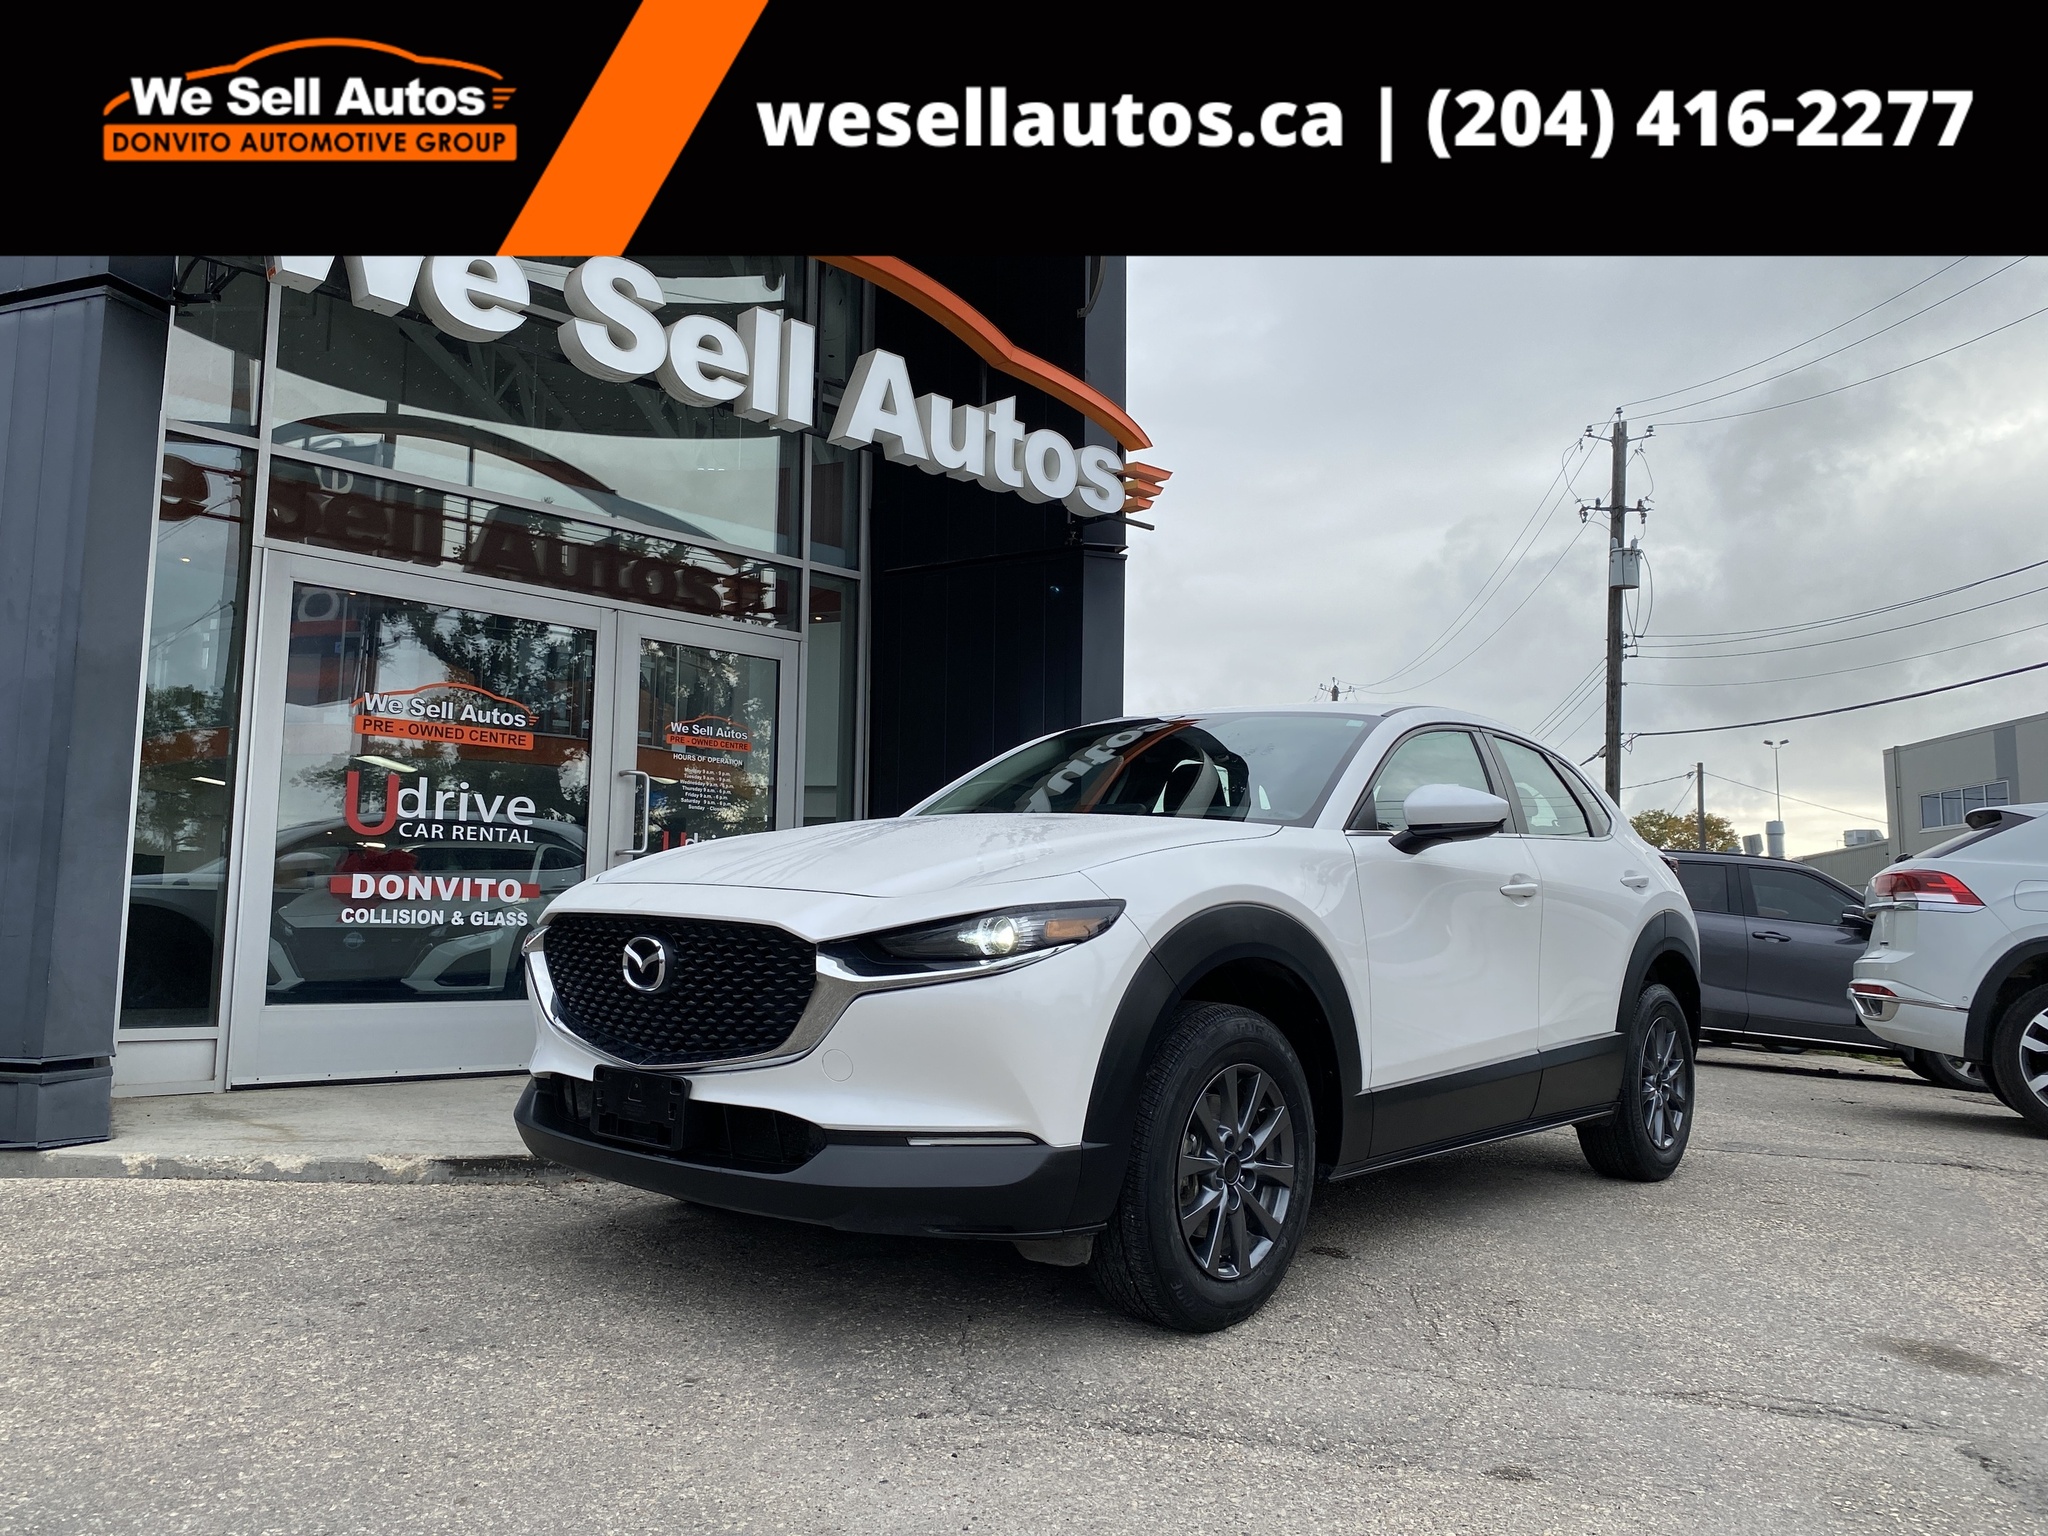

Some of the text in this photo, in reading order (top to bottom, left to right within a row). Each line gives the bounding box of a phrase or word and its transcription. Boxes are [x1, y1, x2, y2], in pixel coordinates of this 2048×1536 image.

[557, 256, 815, 432] Sell
[827, 348, 1126, 517] Autos
[364, 692, 527, 728] We Sell Autos
[362, 719, 394, 733] PRE
[408, 723, 465, 740] OWNED
[468, 730, 528, 746] CENTRE
[670, 721, 748, 740] We Sell Autos
[670, 735, 685, 744] PRE
[692, 738, 719, 747] OWNED
[720, 741, 748, 751] CENTRE
[673, 753, 696, 762] HOURS
[707, 757, 743, 767] OPERATION
[345, 771, 536, 836] Udrive
[398, 822, 534, 844] CAR RENTAL
[351, 873, 522, 903] DONVITO
[341, 908, 528, 926] COLLISION & GLASS
